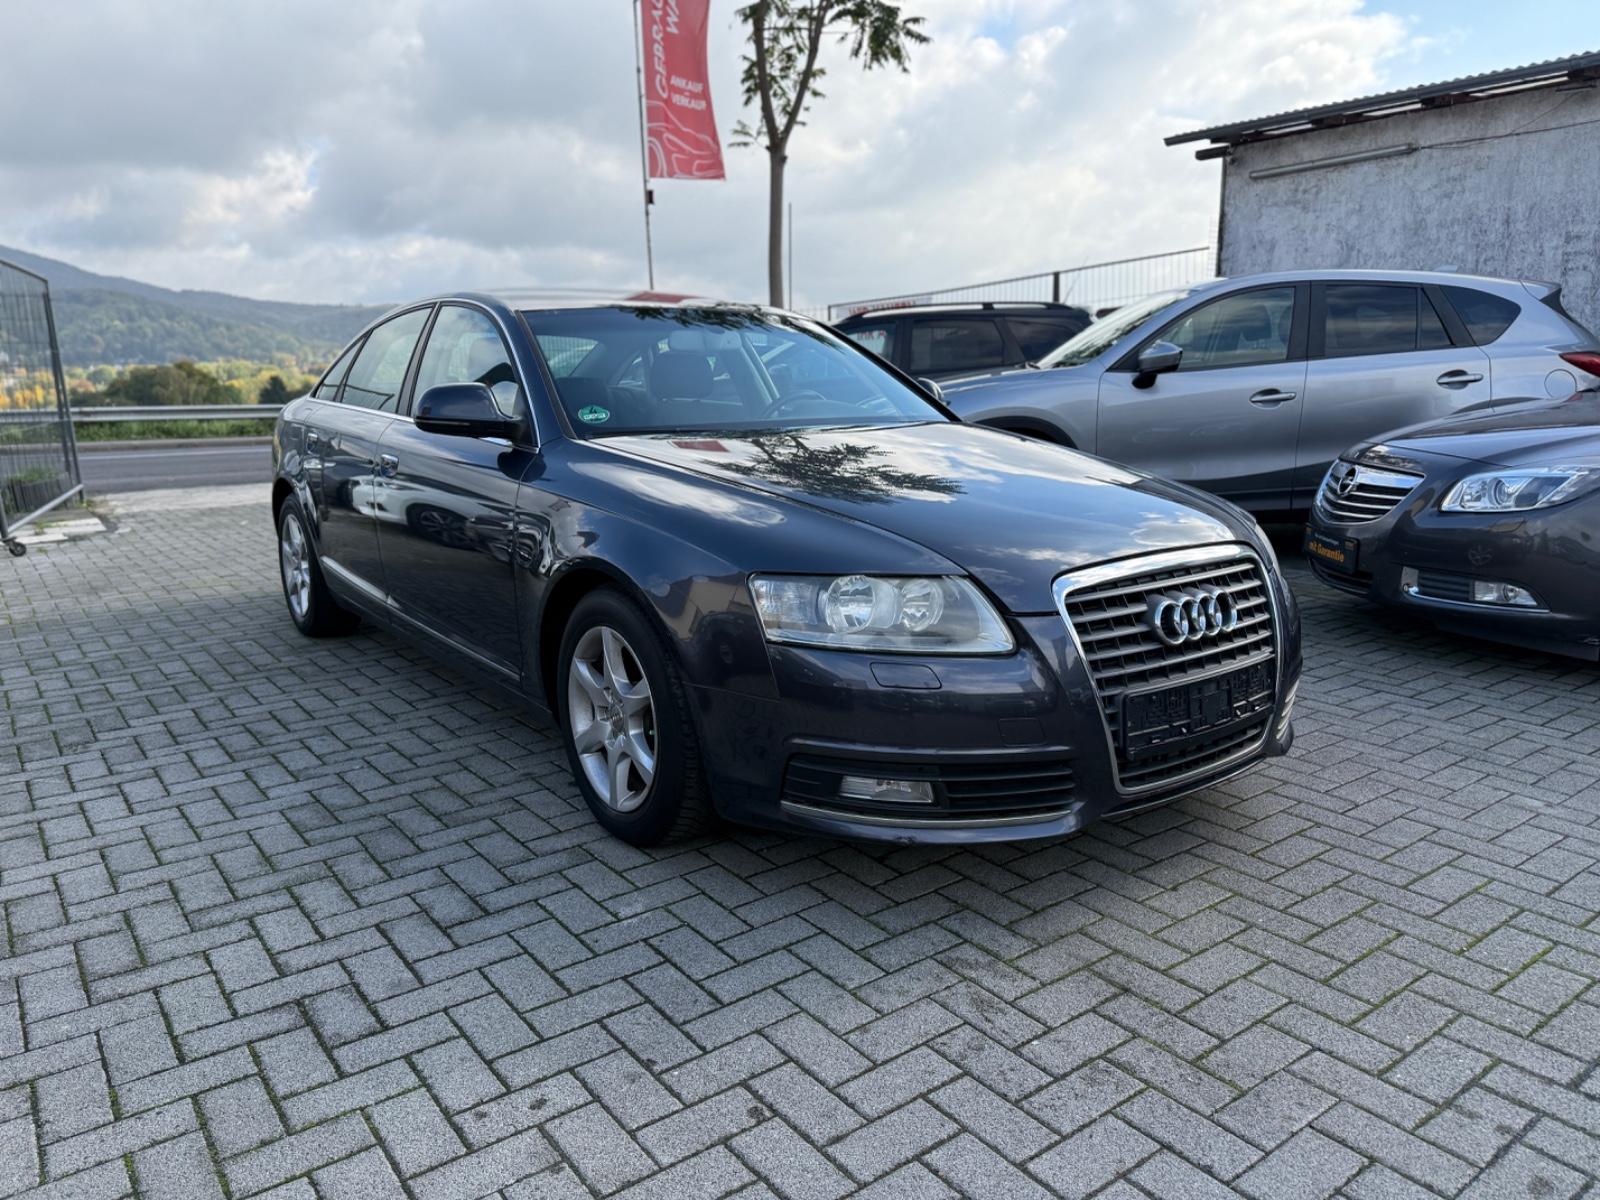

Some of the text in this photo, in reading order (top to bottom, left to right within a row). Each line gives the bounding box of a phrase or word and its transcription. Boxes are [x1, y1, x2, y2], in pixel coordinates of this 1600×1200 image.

[670, 75, 704, 94] ANKAUF
[671, 92, 707, 111] VERKAUF
[1317, 543, 1345, 562] Garantie
